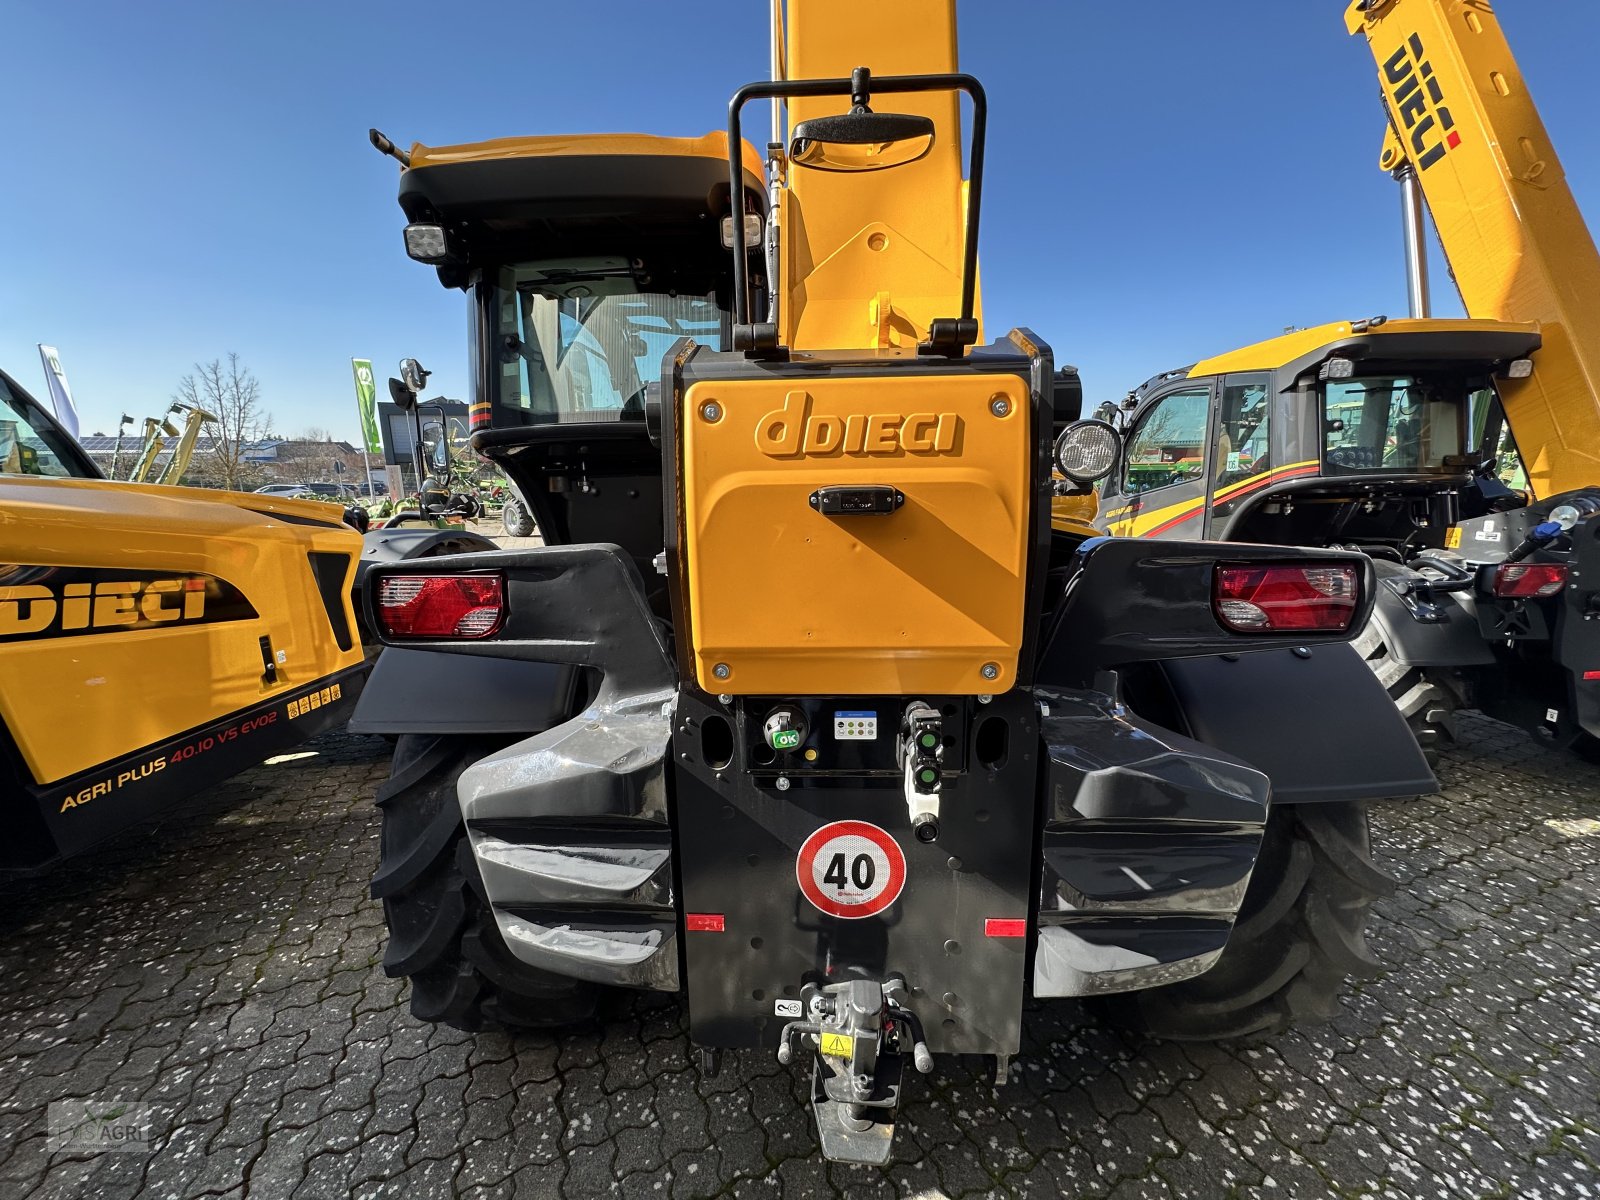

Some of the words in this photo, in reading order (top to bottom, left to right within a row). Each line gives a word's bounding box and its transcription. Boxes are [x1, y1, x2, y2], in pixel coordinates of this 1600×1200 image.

[1382, 32, 1462, 171] DIECI
[0, 580, 206, 635] DIECI
[780, 735, 796, 745] OK
[60, 780, 112, 813] AGRI
[117, 757, 167, 787] PLUS
[170, 738, 214, 763] 40.10
[218, 727, 238, 744] VS
[824, 853, 876, 890] 40
